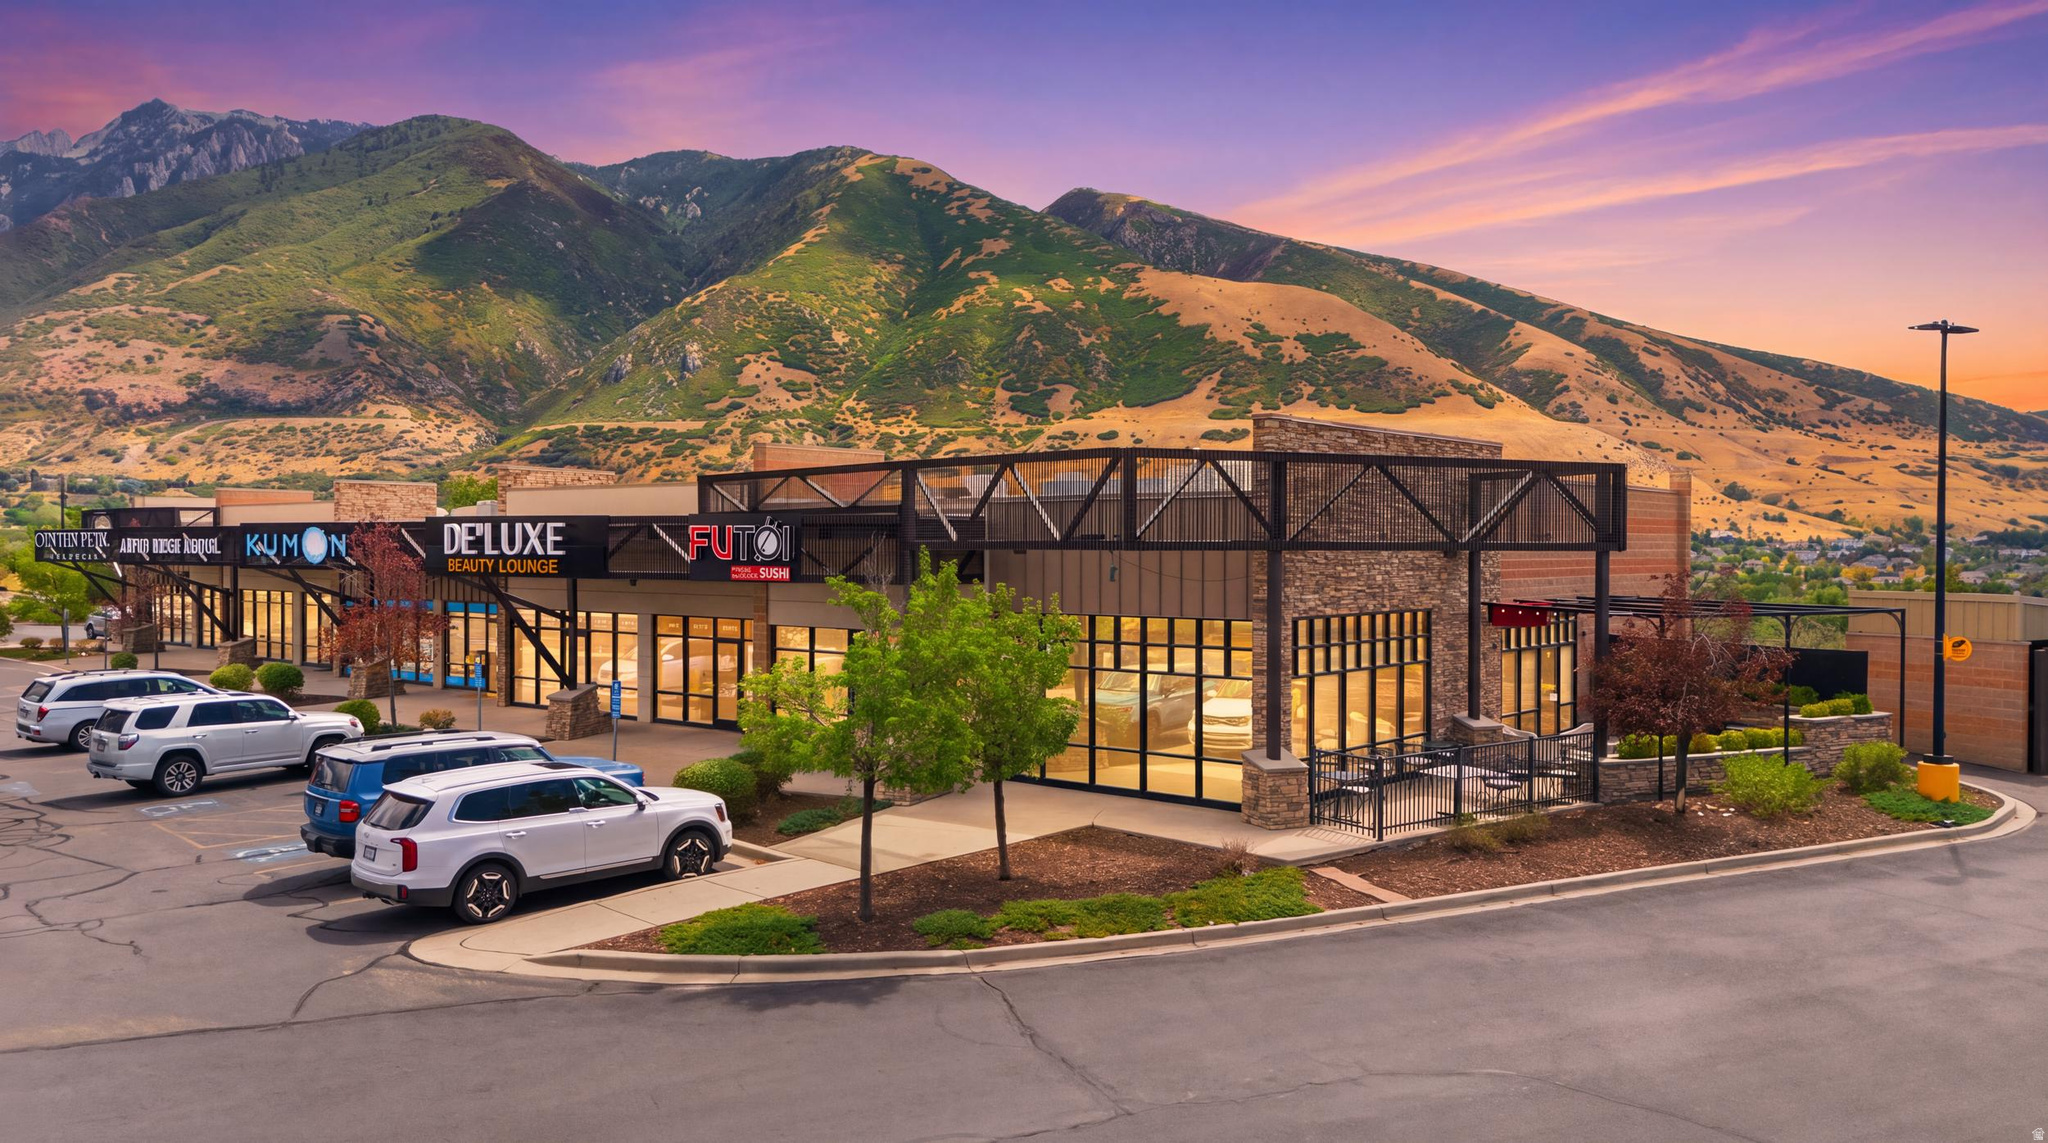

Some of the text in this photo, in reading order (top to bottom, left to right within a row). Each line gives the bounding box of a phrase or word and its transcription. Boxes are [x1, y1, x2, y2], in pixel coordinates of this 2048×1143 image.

[246, 526, 346, 565] KUMON
[444, 522, 566, 555] DE'LUXE
[448, 558, 558, 574] BEAUTY LOUNGE
[759, 567, 789, 579] SUSHI
